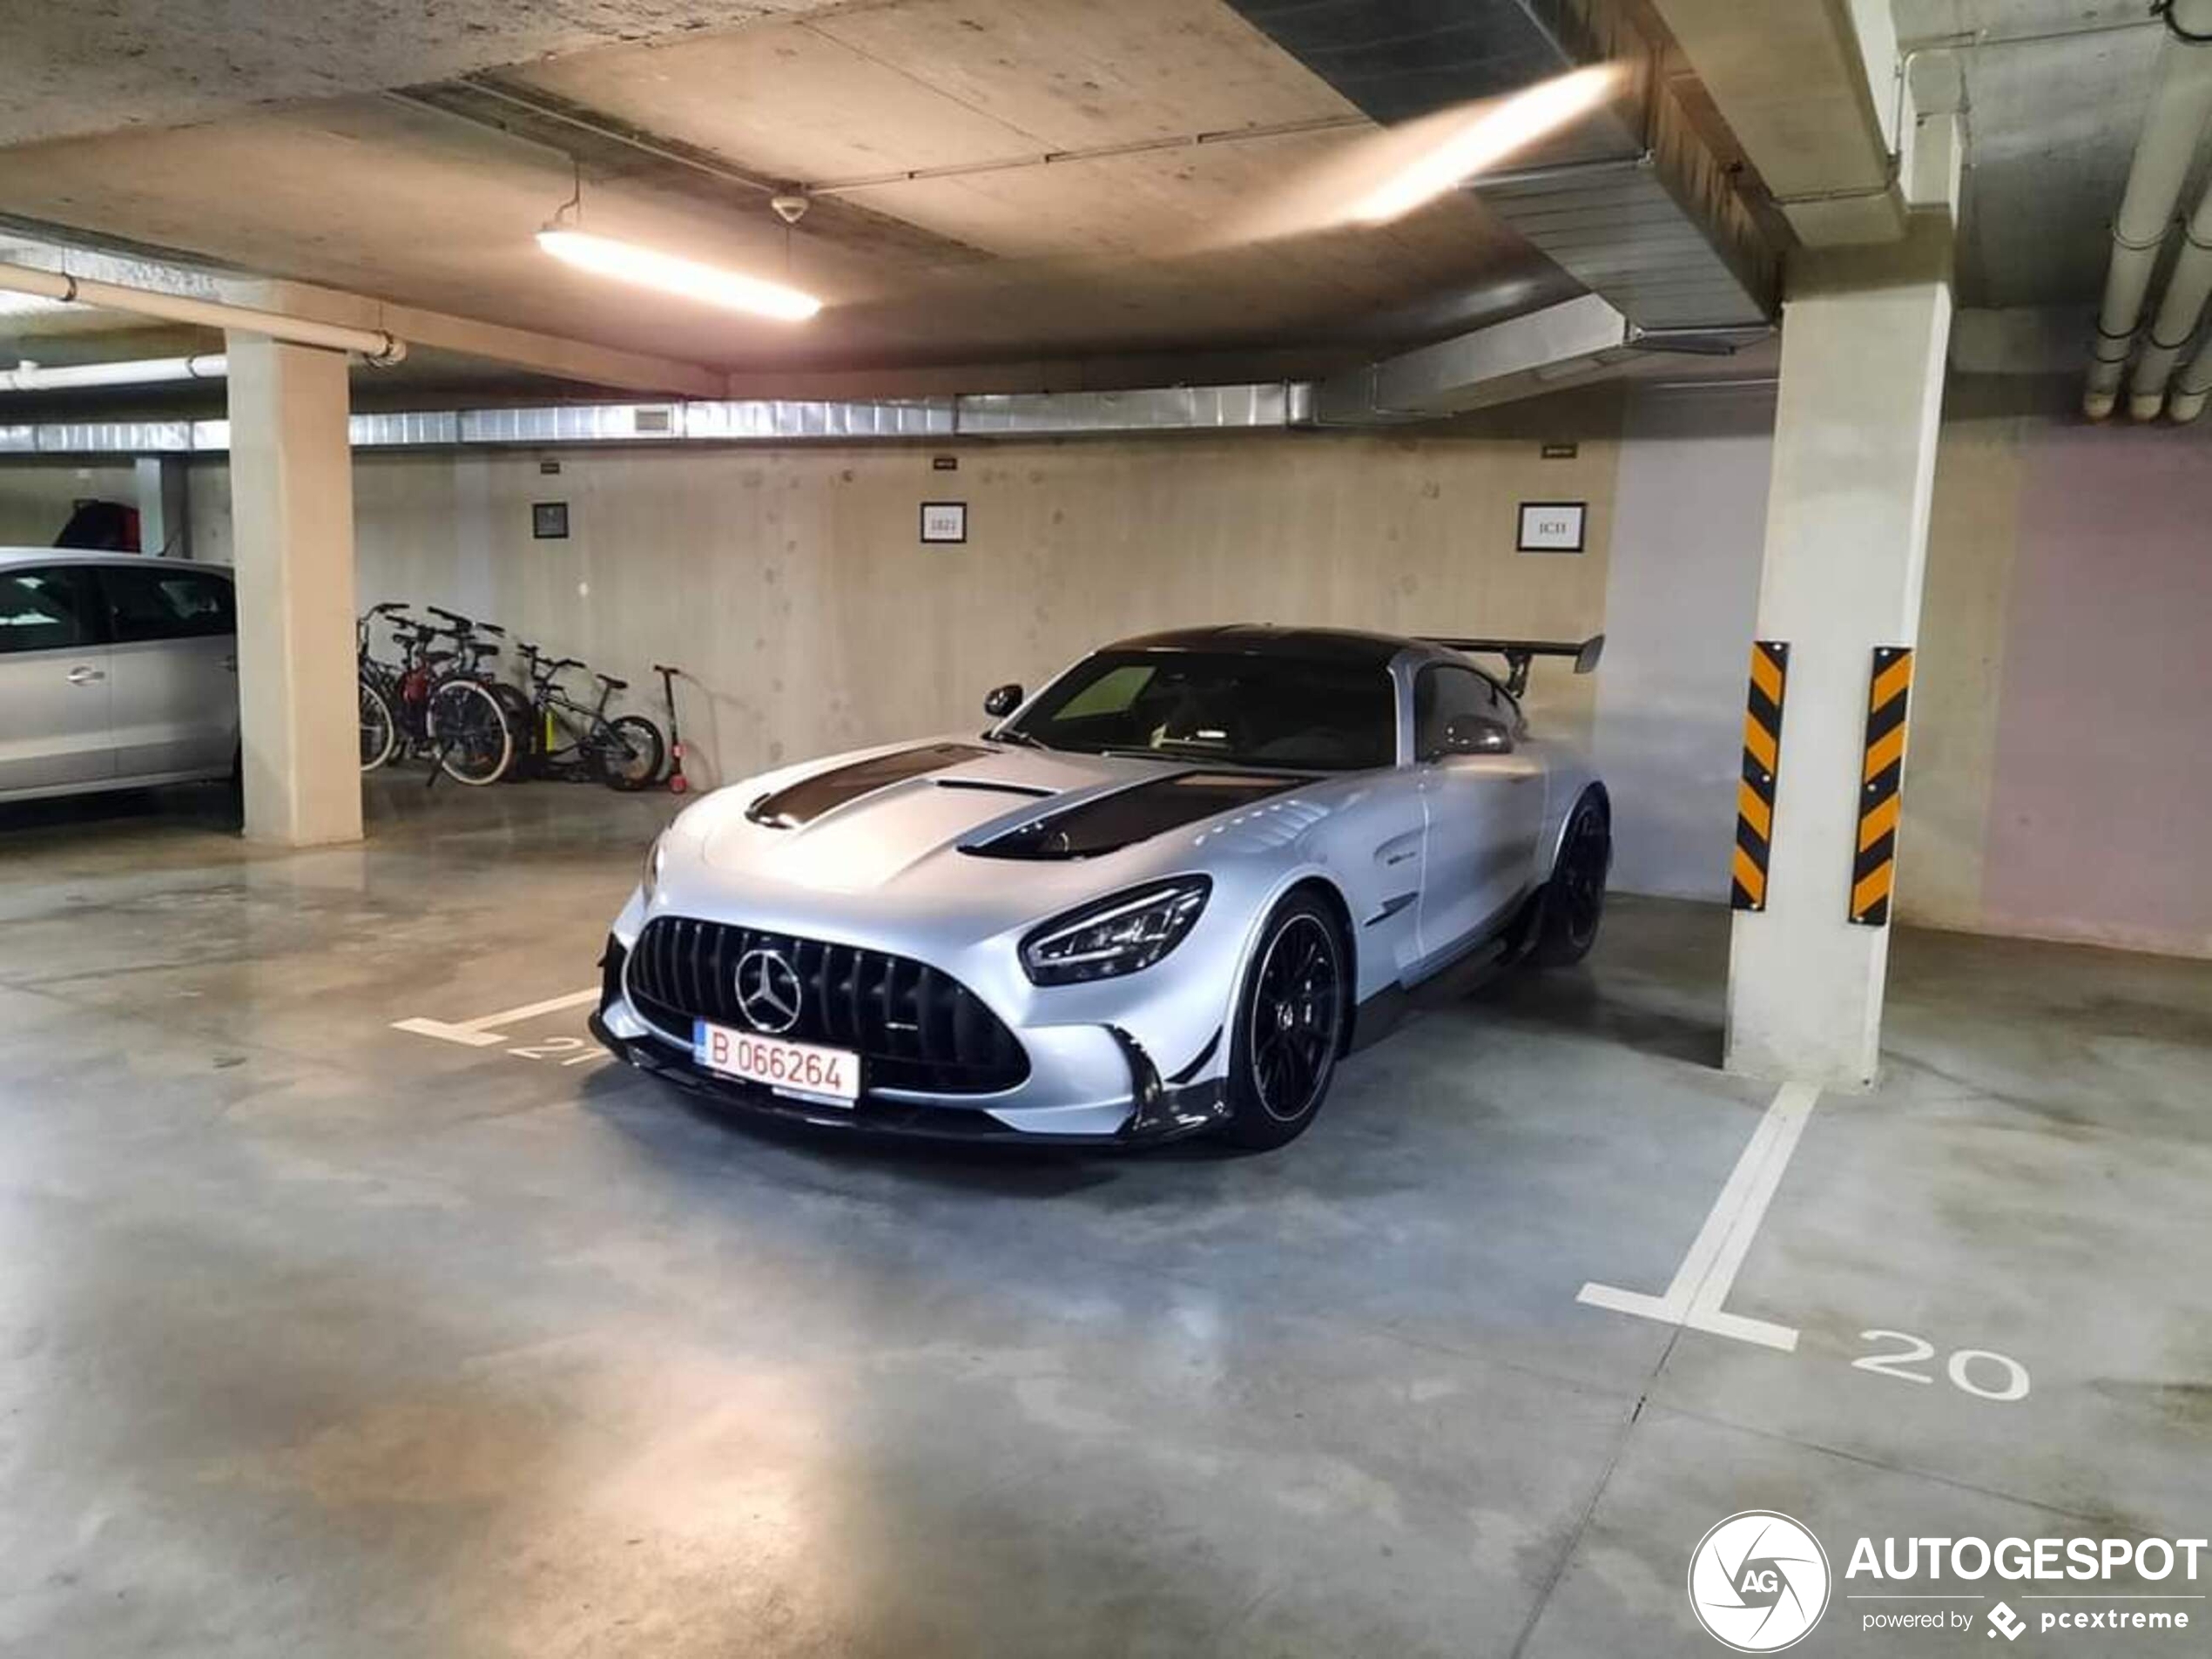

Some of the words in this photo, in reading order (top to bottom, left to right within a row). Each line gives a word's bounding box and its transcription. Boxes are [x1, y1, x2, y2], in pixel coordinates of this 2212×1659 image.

[712, 1031, 729, 1064] B
[738, 1041, 842, 1089] 066264
[1851, 1329, 2030, 1401] 20
